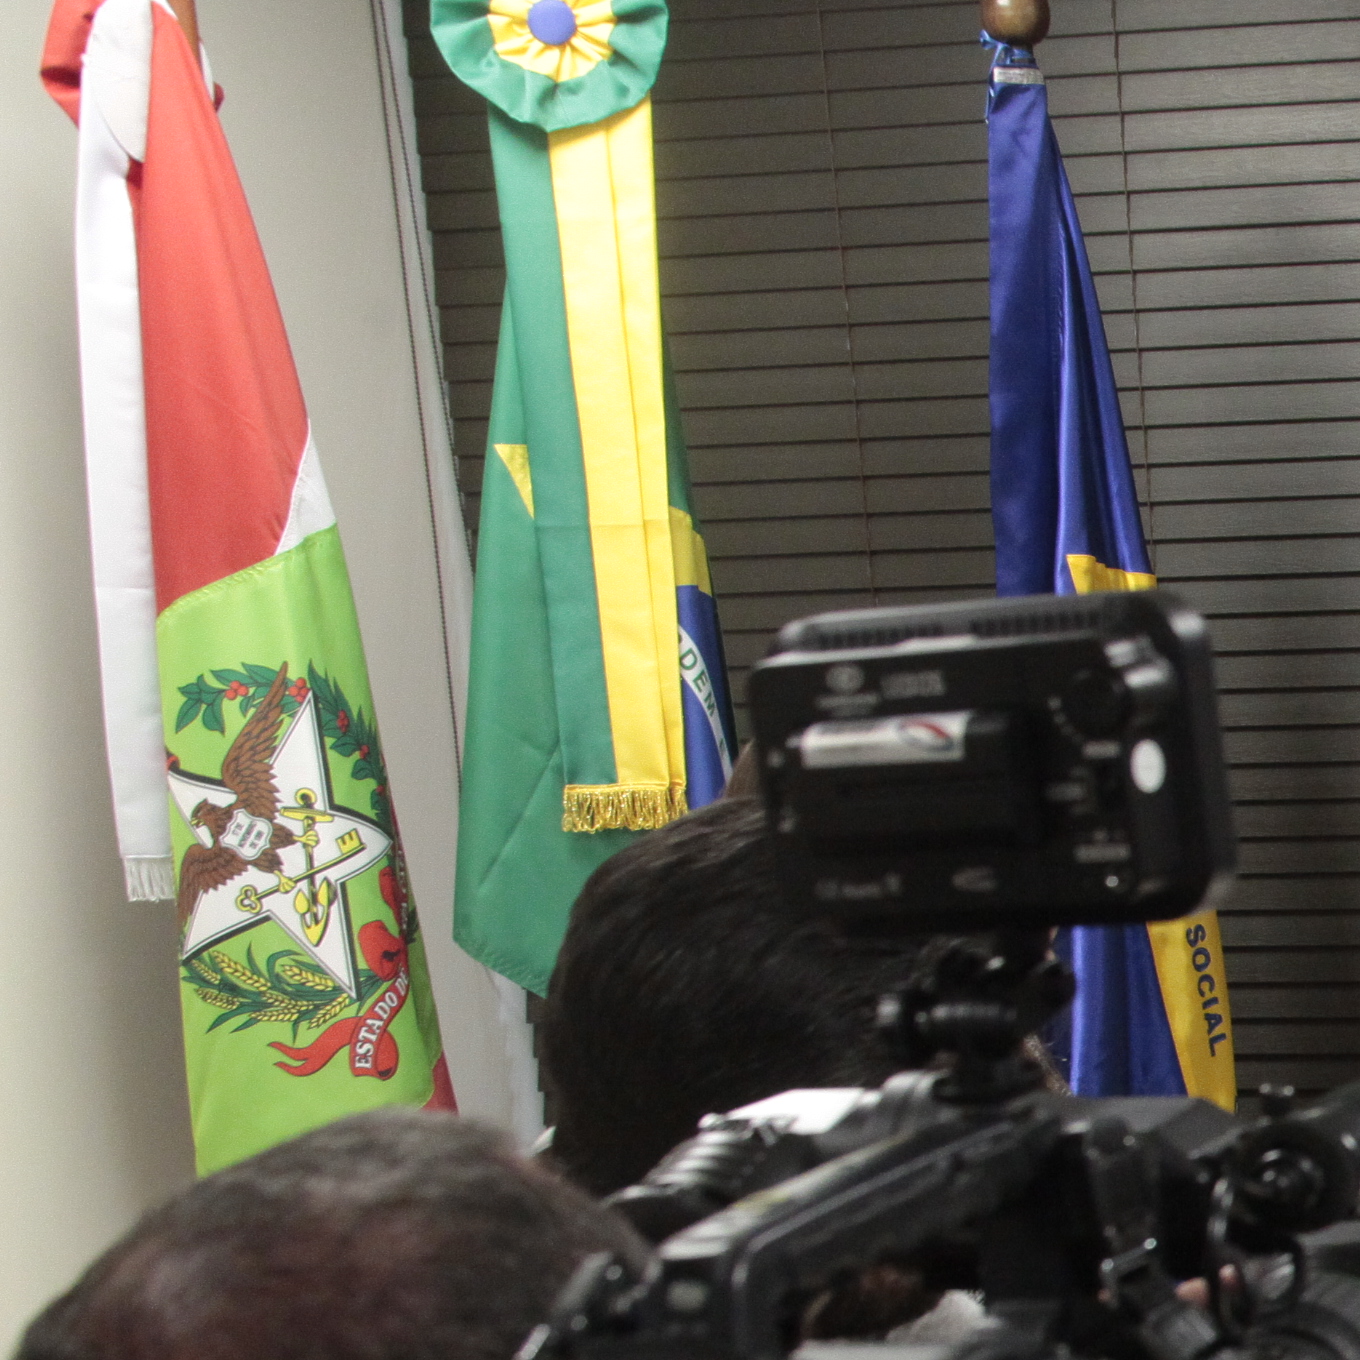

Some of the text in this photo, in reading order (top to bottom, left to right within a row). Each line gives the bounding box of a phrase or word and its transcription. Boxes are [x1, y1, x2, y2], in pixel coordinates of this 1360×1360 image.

[678, 633, 716, 718] DEM
[354, 991, 399, 1069] ESTADO
[1186, 924, 1227, 1057] SOCIAL
